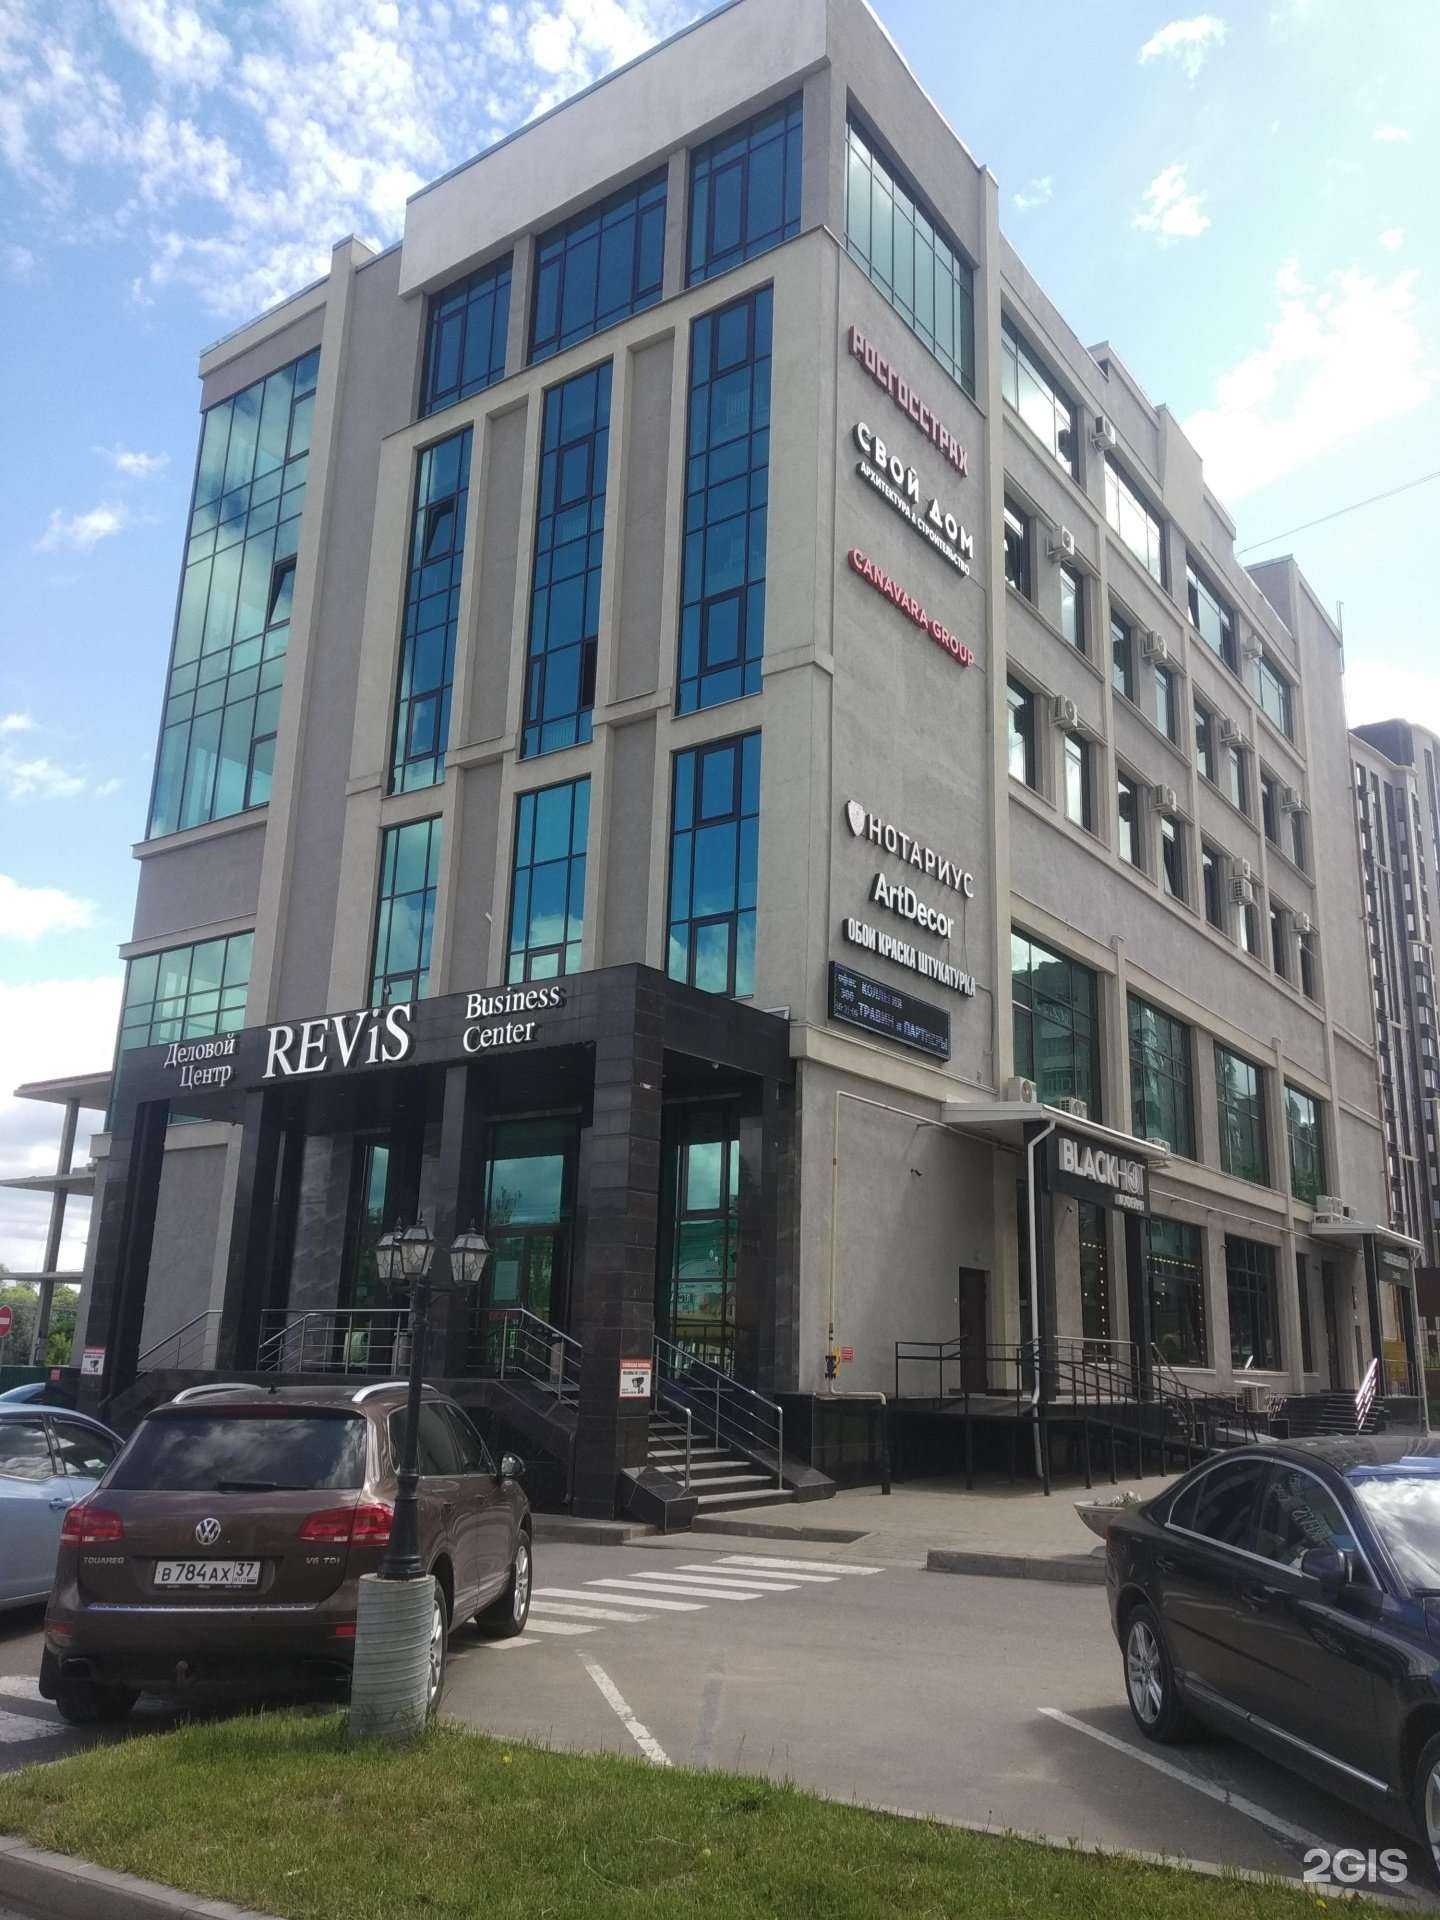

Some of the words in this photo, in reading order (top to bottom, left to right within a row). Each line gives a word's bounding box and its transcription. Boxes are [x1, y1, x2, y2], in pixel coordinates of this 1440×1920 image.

[850, 325, 968, 477] РОСГОССТРАХ
[857, 421, 919, 503] СВОЙ
[929, 498, 974, 559] ДОМ
[860, 461, 911, 518] АРХИТЕКТУРА
[917, 519, 970, 577] СТРОИТЕЛЬСТВО
[851, 548, 929, 630] CANAVARA
[932, 619, 975, 667] GROUP
[869, 814, 974, 898] НОТАРИУС
[874, 873, 954, 939] ArtDecor
[848, 918, 876, 950] ОБОИ
[878, 931, 916, 969] КРАСКА
[918, 950, 976, 996] ШТУКАТУРКА
[462, 1019, 536, 1053] Center
[464, 985, 561, 1020] Business
[163, 1033, 236, 1069] Деловой
[179, 1064, 232, 1089] Центр
[262, 1004, 412, 1079] REViS
